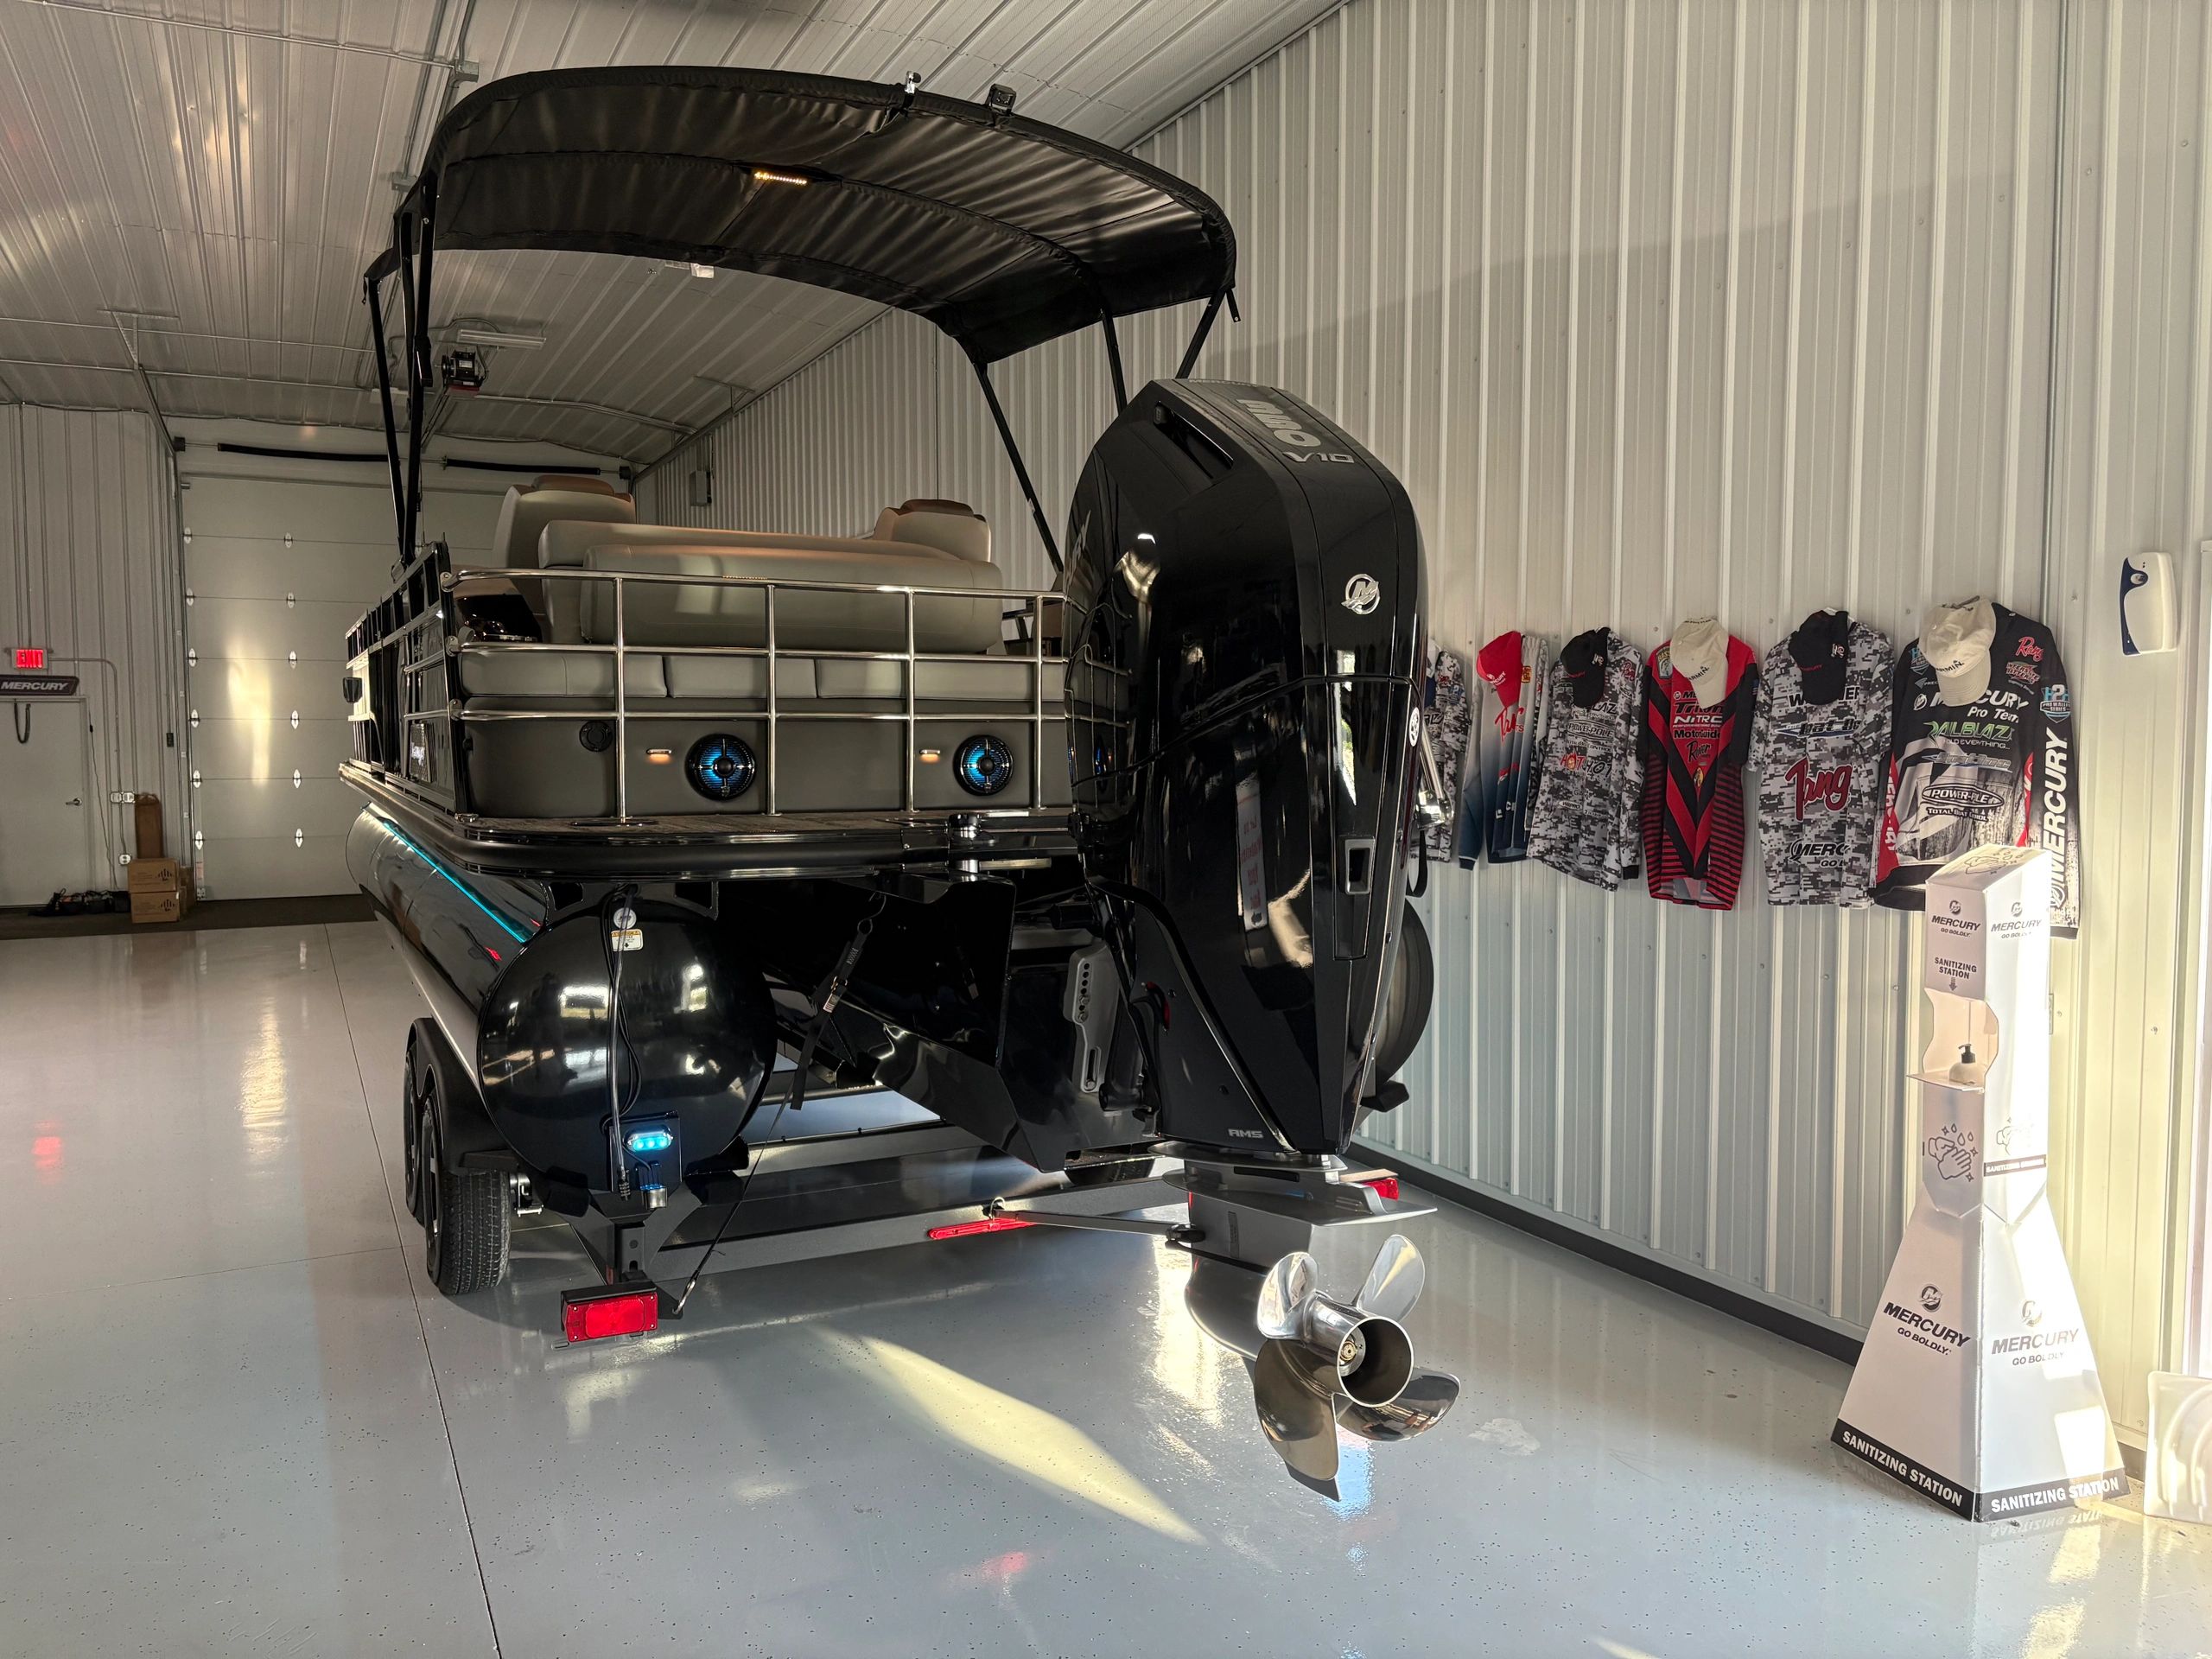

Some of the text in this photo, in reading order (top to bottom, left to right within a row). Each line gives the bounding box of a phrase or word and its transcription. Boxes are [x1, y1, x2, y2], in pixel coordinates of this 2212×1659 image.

[1282, 451, 1355, 464] V10
[1, 681, 69, 690] MERCURY
[1929, 690, 2030, 711] MCURY
[1967, 706, 1988, 718] Pro
[1931, 915, 1981, 931] MERCURY
[1990, 919, 2042, 932] MERCURY
[1934, 957, 1978, 973] SANITIZING
[1939, 966, 1970, 979] STATION
[1228, 1128, 1264, 1139] AMS
[1883, 1302, 1972, 1348] MERCURY
[1897, 1326, 1911, 1338] GO
[1991, 1328, 2080, 1355] MERCURY
[2012, 1357, 2026, 1366] GO
[1841, 1430, 1908, 1478] SANITIZING
[1909, 1468, 1963, 1508] STATION
[1990, 1476, 2120, 1514] SANITIZING STATION
